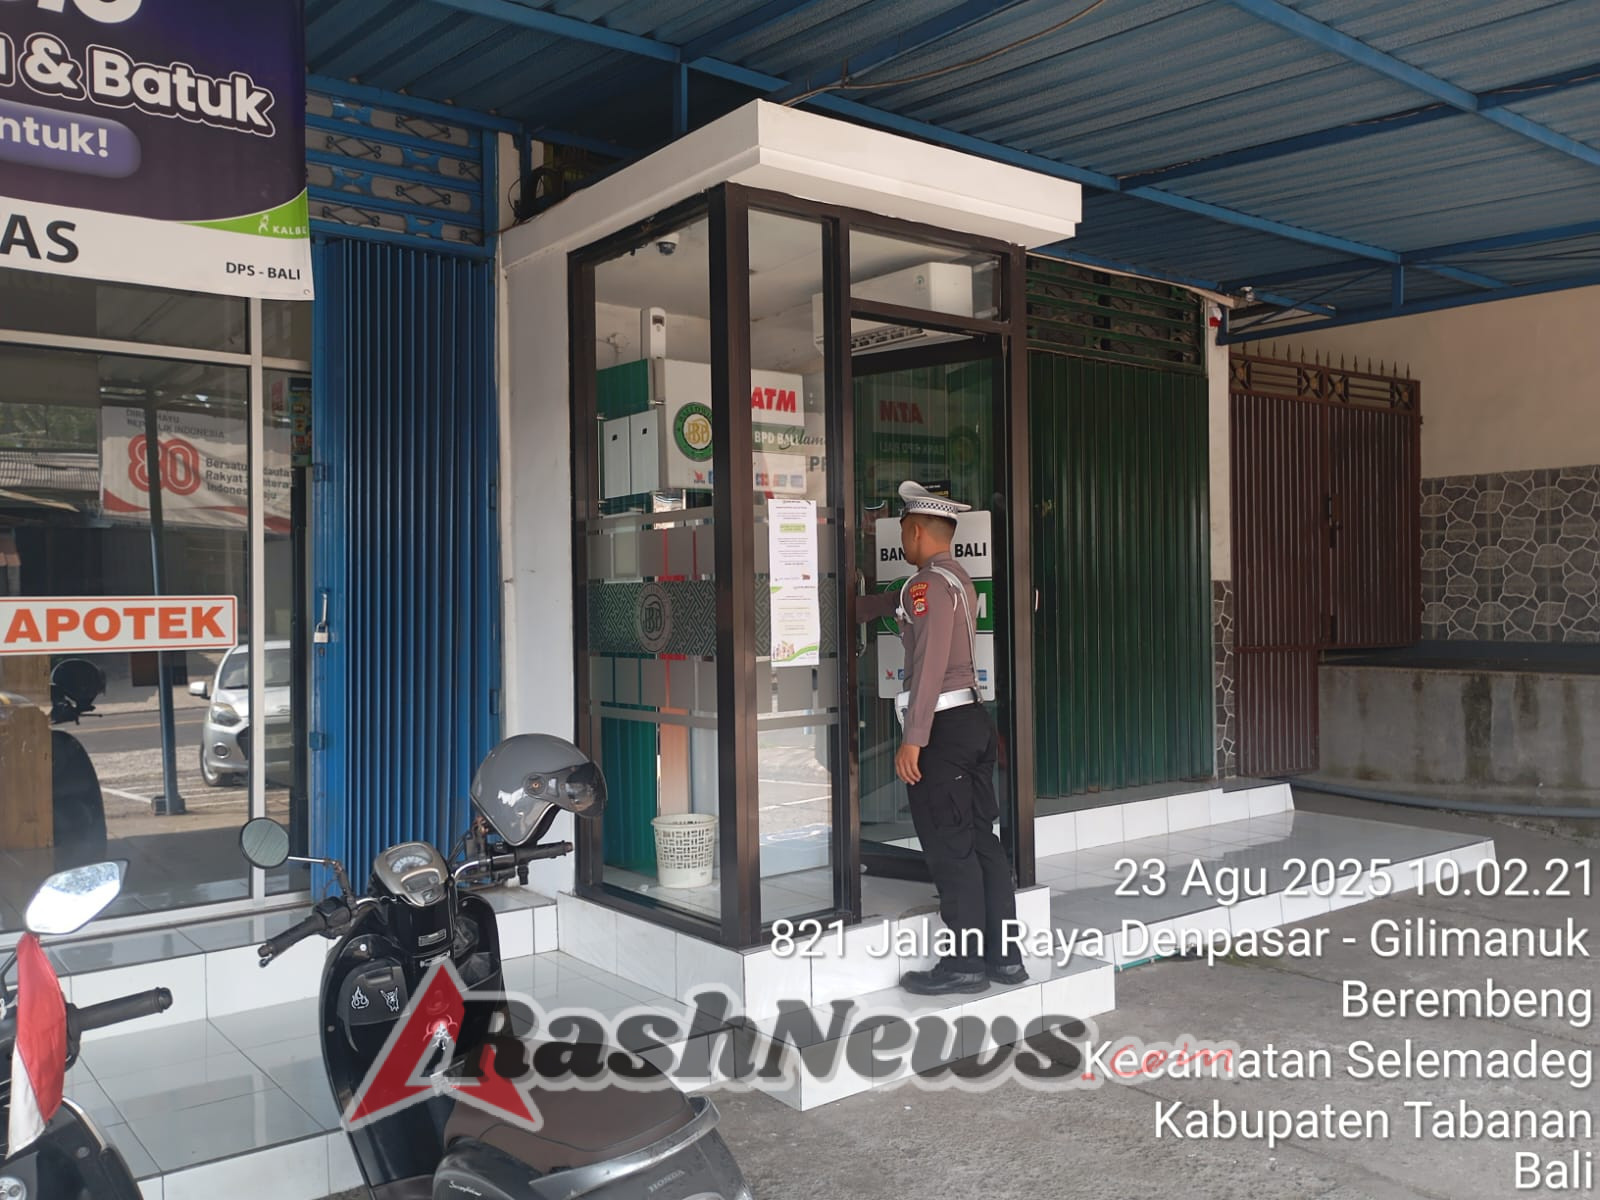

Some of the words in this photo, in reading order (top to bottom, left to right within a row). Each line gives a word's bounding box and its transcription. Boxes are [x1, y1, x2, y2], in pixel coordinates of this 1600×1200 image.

[24, 37, 78, 90] &
[92, 48, 270, 128] Batuk
[0, 115, 109, 158] ntuk!
[0, 213, 80, 264] AS
[225, 261, 256, 277] DPS
[267, 266, 301, 280] BALI
[751, 386, 797, 414] ATM
[754, 431, 775, 444] BPD
[206, 457, 248, 472] Bersatu
[206, 470, 243, 485] Rakyat
[207, 482, 248, 496] Indones
[880, 547, 906, 562] BAN
[954, 542, 987, 558] BALI
[4, 605, 226, 643] APOTEK
